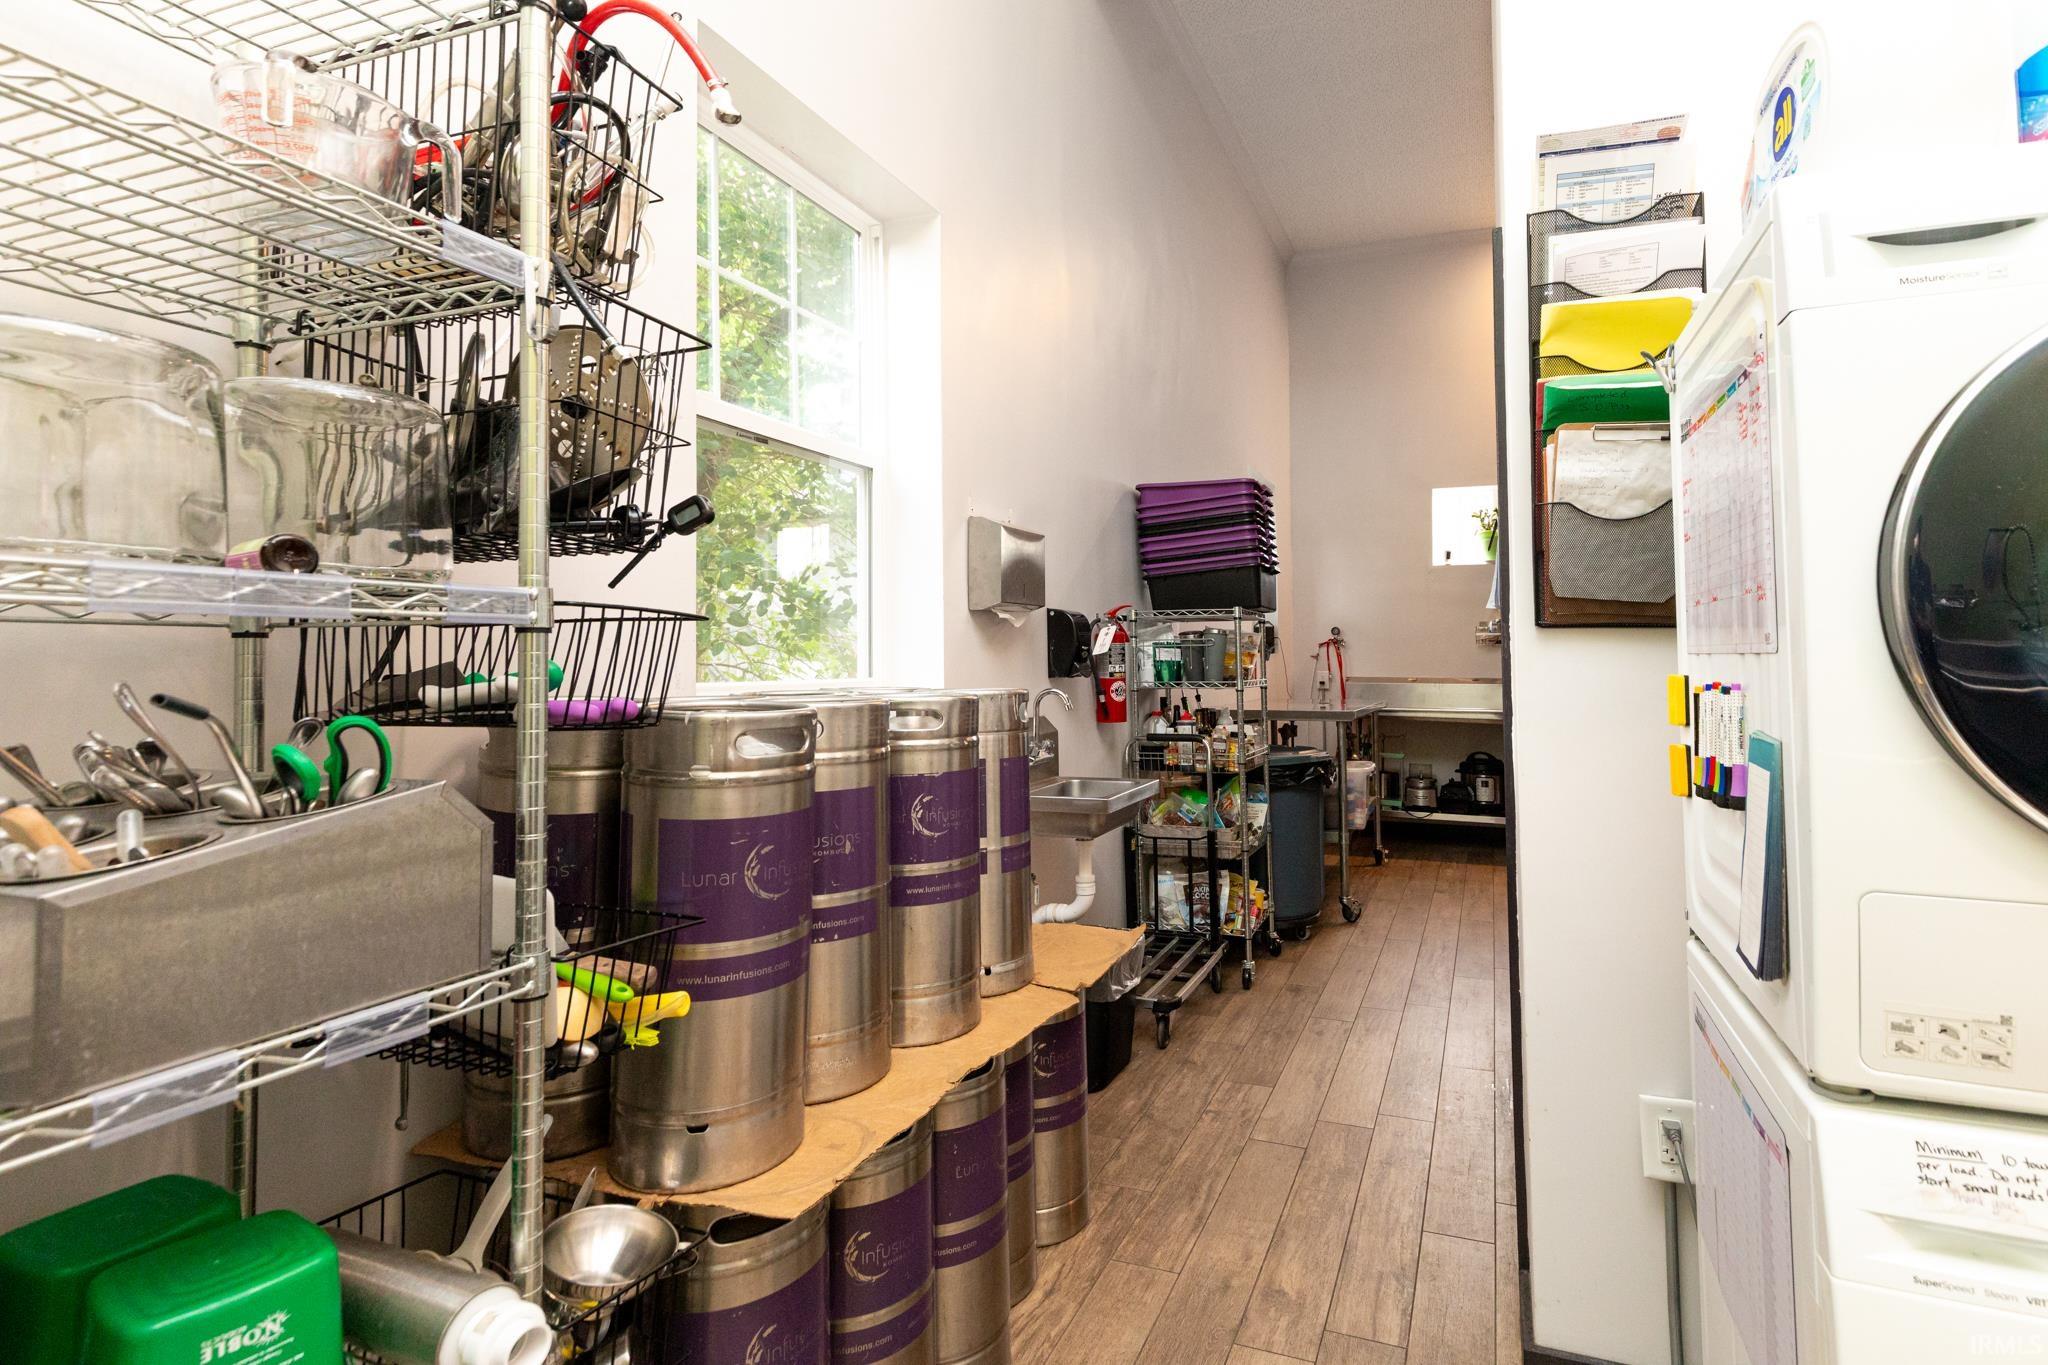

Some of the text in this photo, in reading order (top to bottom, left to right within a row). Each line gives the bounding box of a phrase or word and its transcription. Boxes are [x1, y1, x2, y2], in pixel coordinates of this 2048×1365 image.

[1774, 93, 1793, 153] all
[681, 871, 738, 888] Lunar
[812, 914, 865, 930] nfusions.com
[677, 960, 791, 986] www.lunarinfusions.com
[1915, 1140, 1984, 1162] Minimum
[2001, 1154, 2018, 1168] 10
[1917, 1162, 1940, 1174] per
[1990, 1168, 2010, 1183] Do
[2016, 1174, 2042, 1187] not
[1918, 1175, 1952, 1189] start
[1963, 1183, 1999, 1196] small
[200, 1308, 291, 1365] NOBLE
